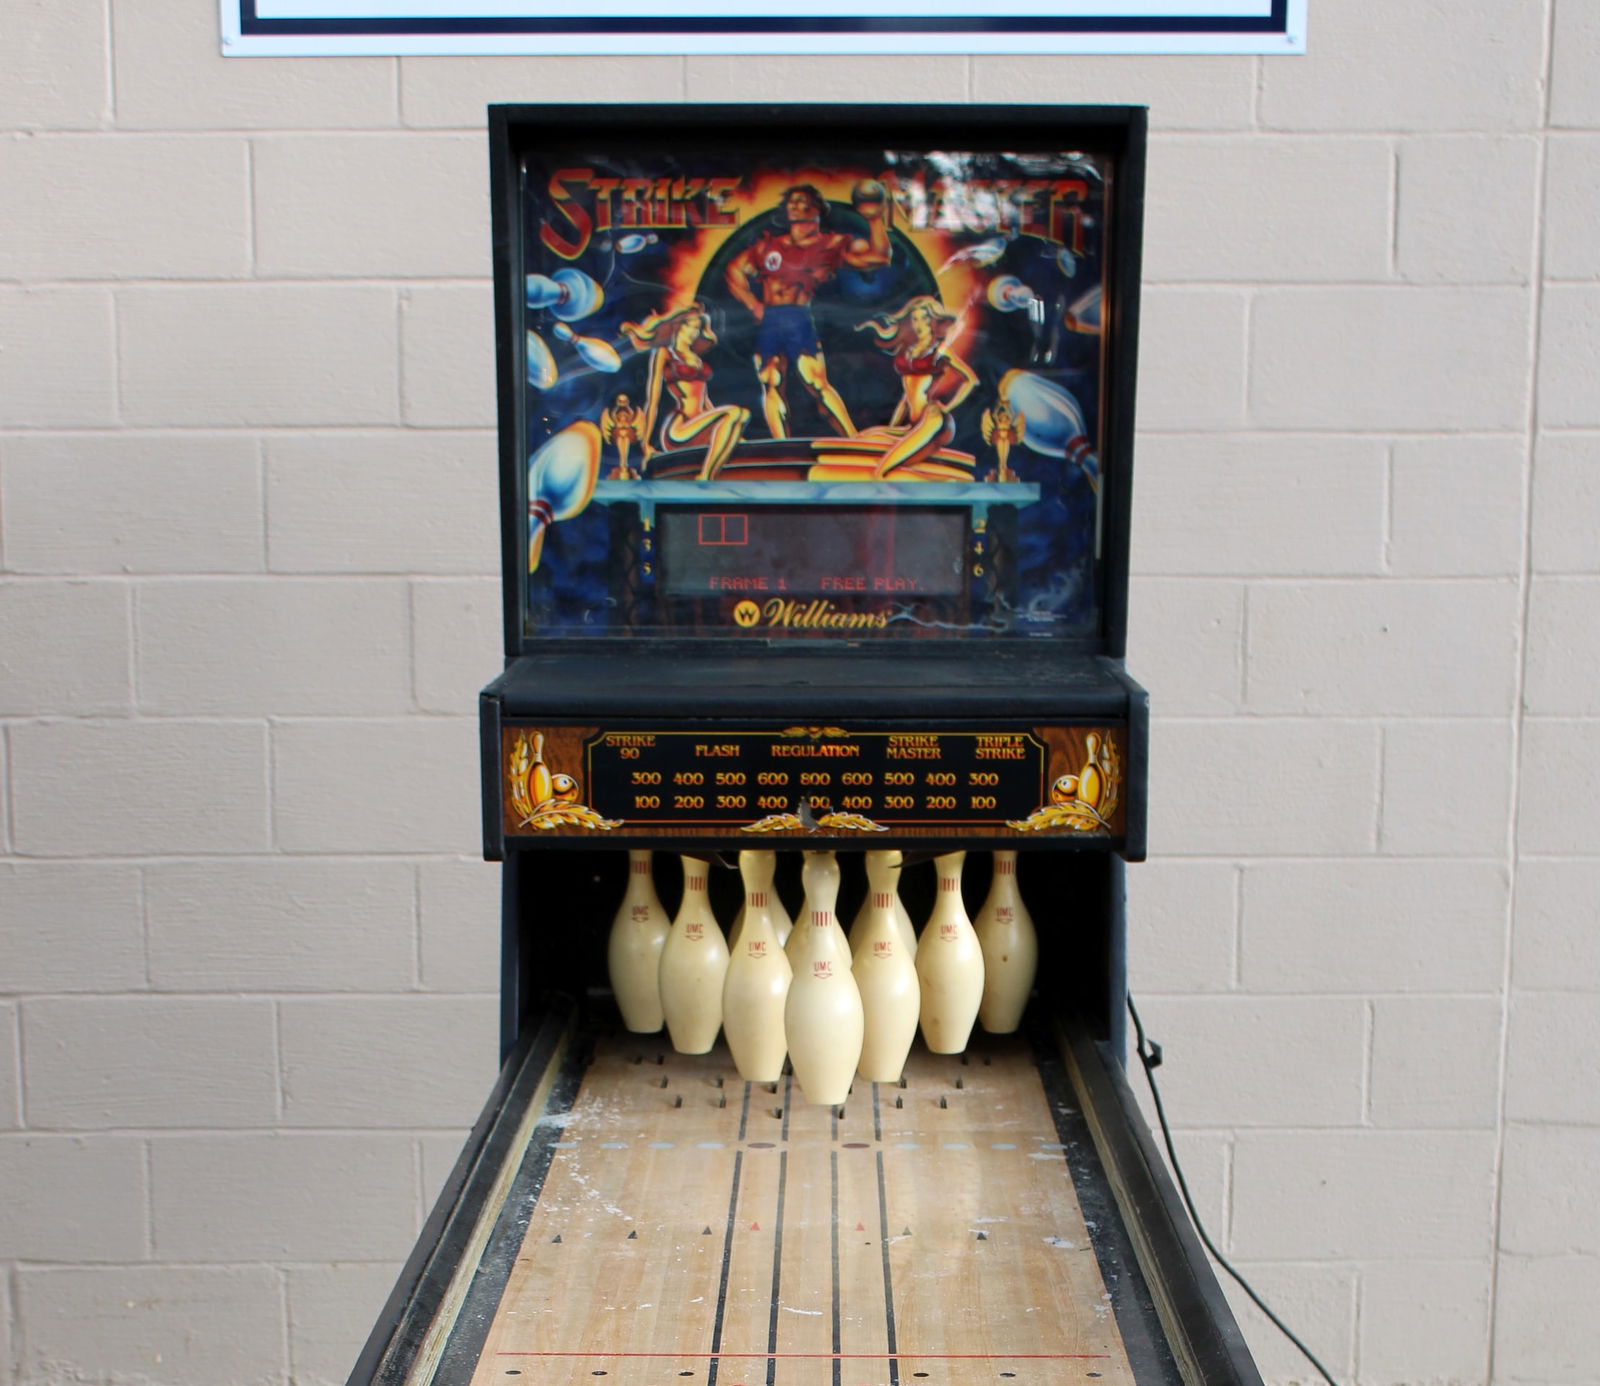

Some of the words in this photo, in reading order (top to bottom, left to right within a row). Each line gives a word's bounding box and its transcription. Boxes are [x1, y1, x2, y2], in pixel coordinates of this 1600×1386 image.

[539, 168, 742, 260] STRIKE
[709, 576, 769, 590] FRAME
[778, 577, 787, 590] 1
[820, 577, 866, 591] FREE
[764, 597, 889, 628] Williams
[606, 735, 656, 748] STRIKE
[888, 736, 939, 748] STRIKE
[976, 736, 1024, 748] TRIPLE
[620, 747, 640, 760] 90
[695, 744, 740, 757] FLASH
[771, 745, 860, 757] REGULATION
[885, 748, 942, 760] MASTER
[975, 748, 1026, 760] STRIKE
[632, 772, 661, 786] 300
[673, 772, 704, 786] 400
[715, 772, 746, 786] 500
[757, 772, 789, 786] 600
[800, 772, 830, 786] 800
[841, 772, 873, 786] 600
[884, 772, 915, 786] 500
[925, 772, 956, 786] 400
[968, 772, 999, 786] 300
[635, 796, 660, 809] 100
[674, 796, 704, 809] 200
[716, 796, 747, 809] 300
[757, 796, 788, 809] 400
[800, 796, 831, 809] 00
[841, 796, 873, 809] 400
[884, 796, 914, 809] 300
[926, 796, 957, 809] 200
[970, 796, 996, 809] 100
[632, 906, 649, 916] UMC
[997, 907, 1015, 917] UMC
[686, 923, 703, 933] UMC
[941, 925, 958, 934] UMC
[749, 941, 766, 951] UMC
[874, 941, 892, 951] UMC
[814, 961, 832, 971] UMC
